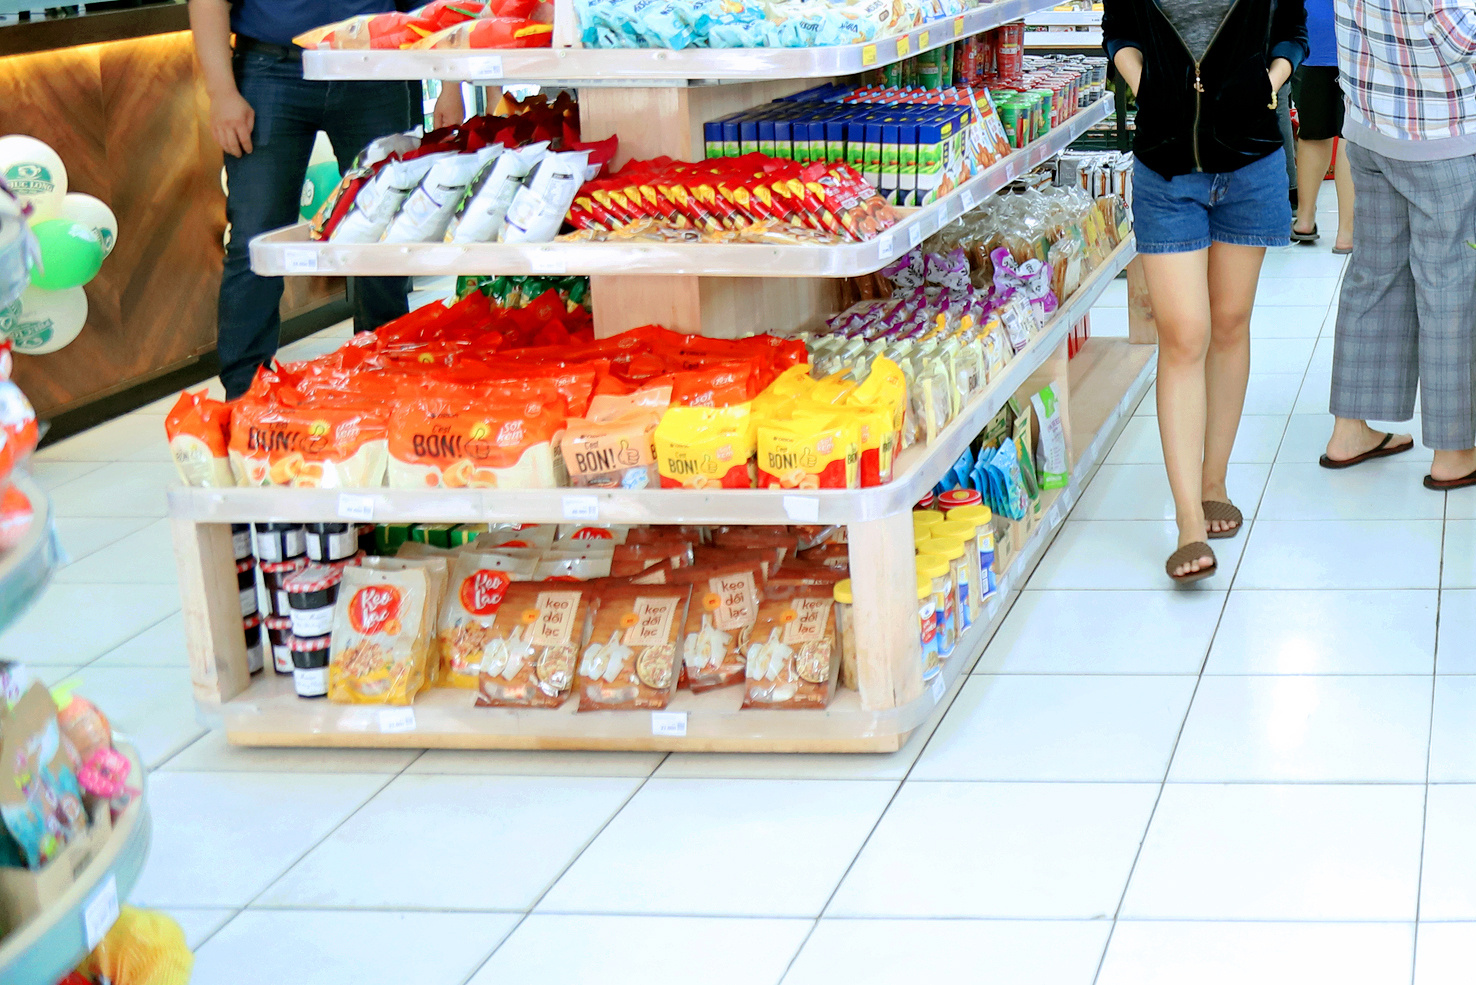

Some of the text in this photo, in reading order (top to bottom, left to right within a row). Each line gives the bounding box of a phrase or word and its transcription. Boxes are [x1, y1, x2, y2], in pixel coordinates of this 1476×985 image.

[412, 434, 462, 458] BON!
[575, 448, 616, 473] BON!
[668, 457, 699, 475] BON!
[768, 452, 798, 469] BON!
[721, 581, 745, 592] kẹo
[545, 599, 569, 610] kẹo
[645, 604, 667, 617] kẹo
[801, 598, 824, 611] kẹo
[729, 607, 748, 620] lạc
[541, 624, 561, 638] lạc
[640, 626, 658, 638] lạc
[798, 622, 816, 634] lạc
